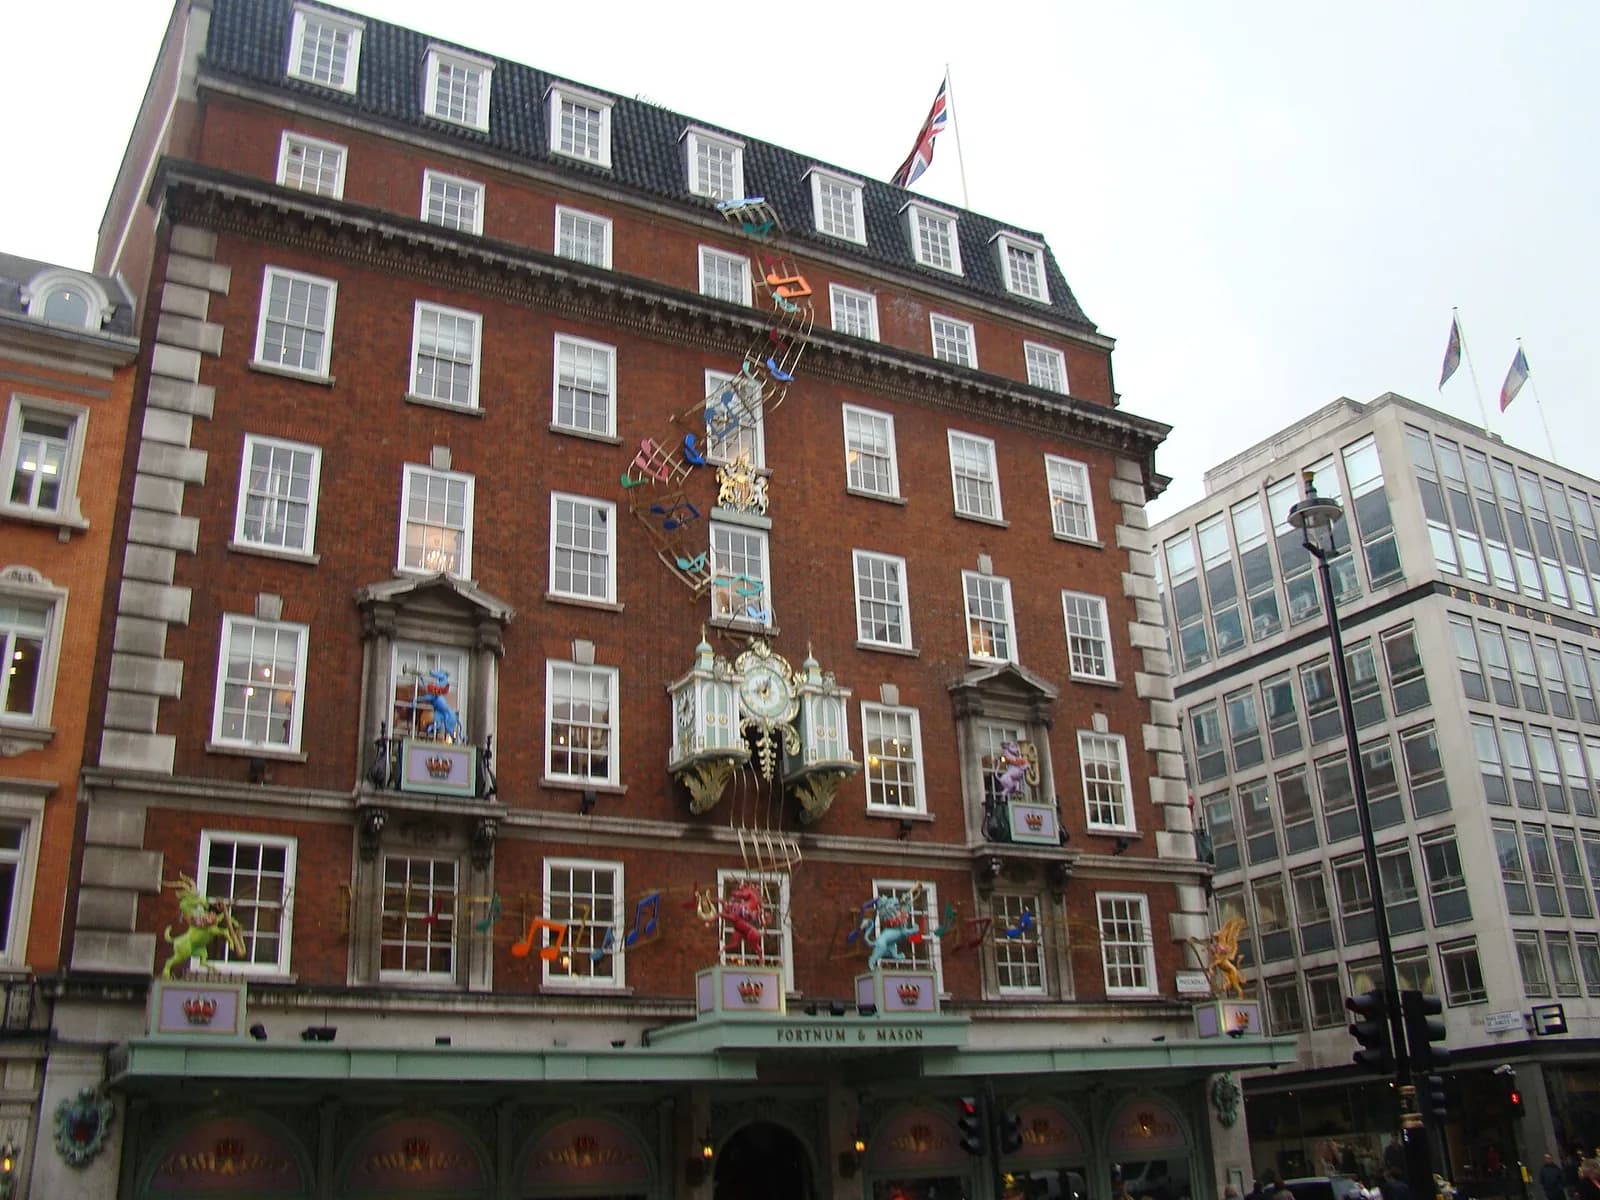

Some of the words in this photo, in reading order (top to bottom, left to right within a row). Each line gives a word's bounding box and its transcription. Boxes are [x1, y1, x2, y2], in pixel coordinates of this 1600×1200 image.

[1449, 587, 1553, 625] FRENCH
[777, 1028, 846, 1042] FORTNUM
[857, 1029, 866, 1041] &
[876, 1028, 924, 1042] MASON
